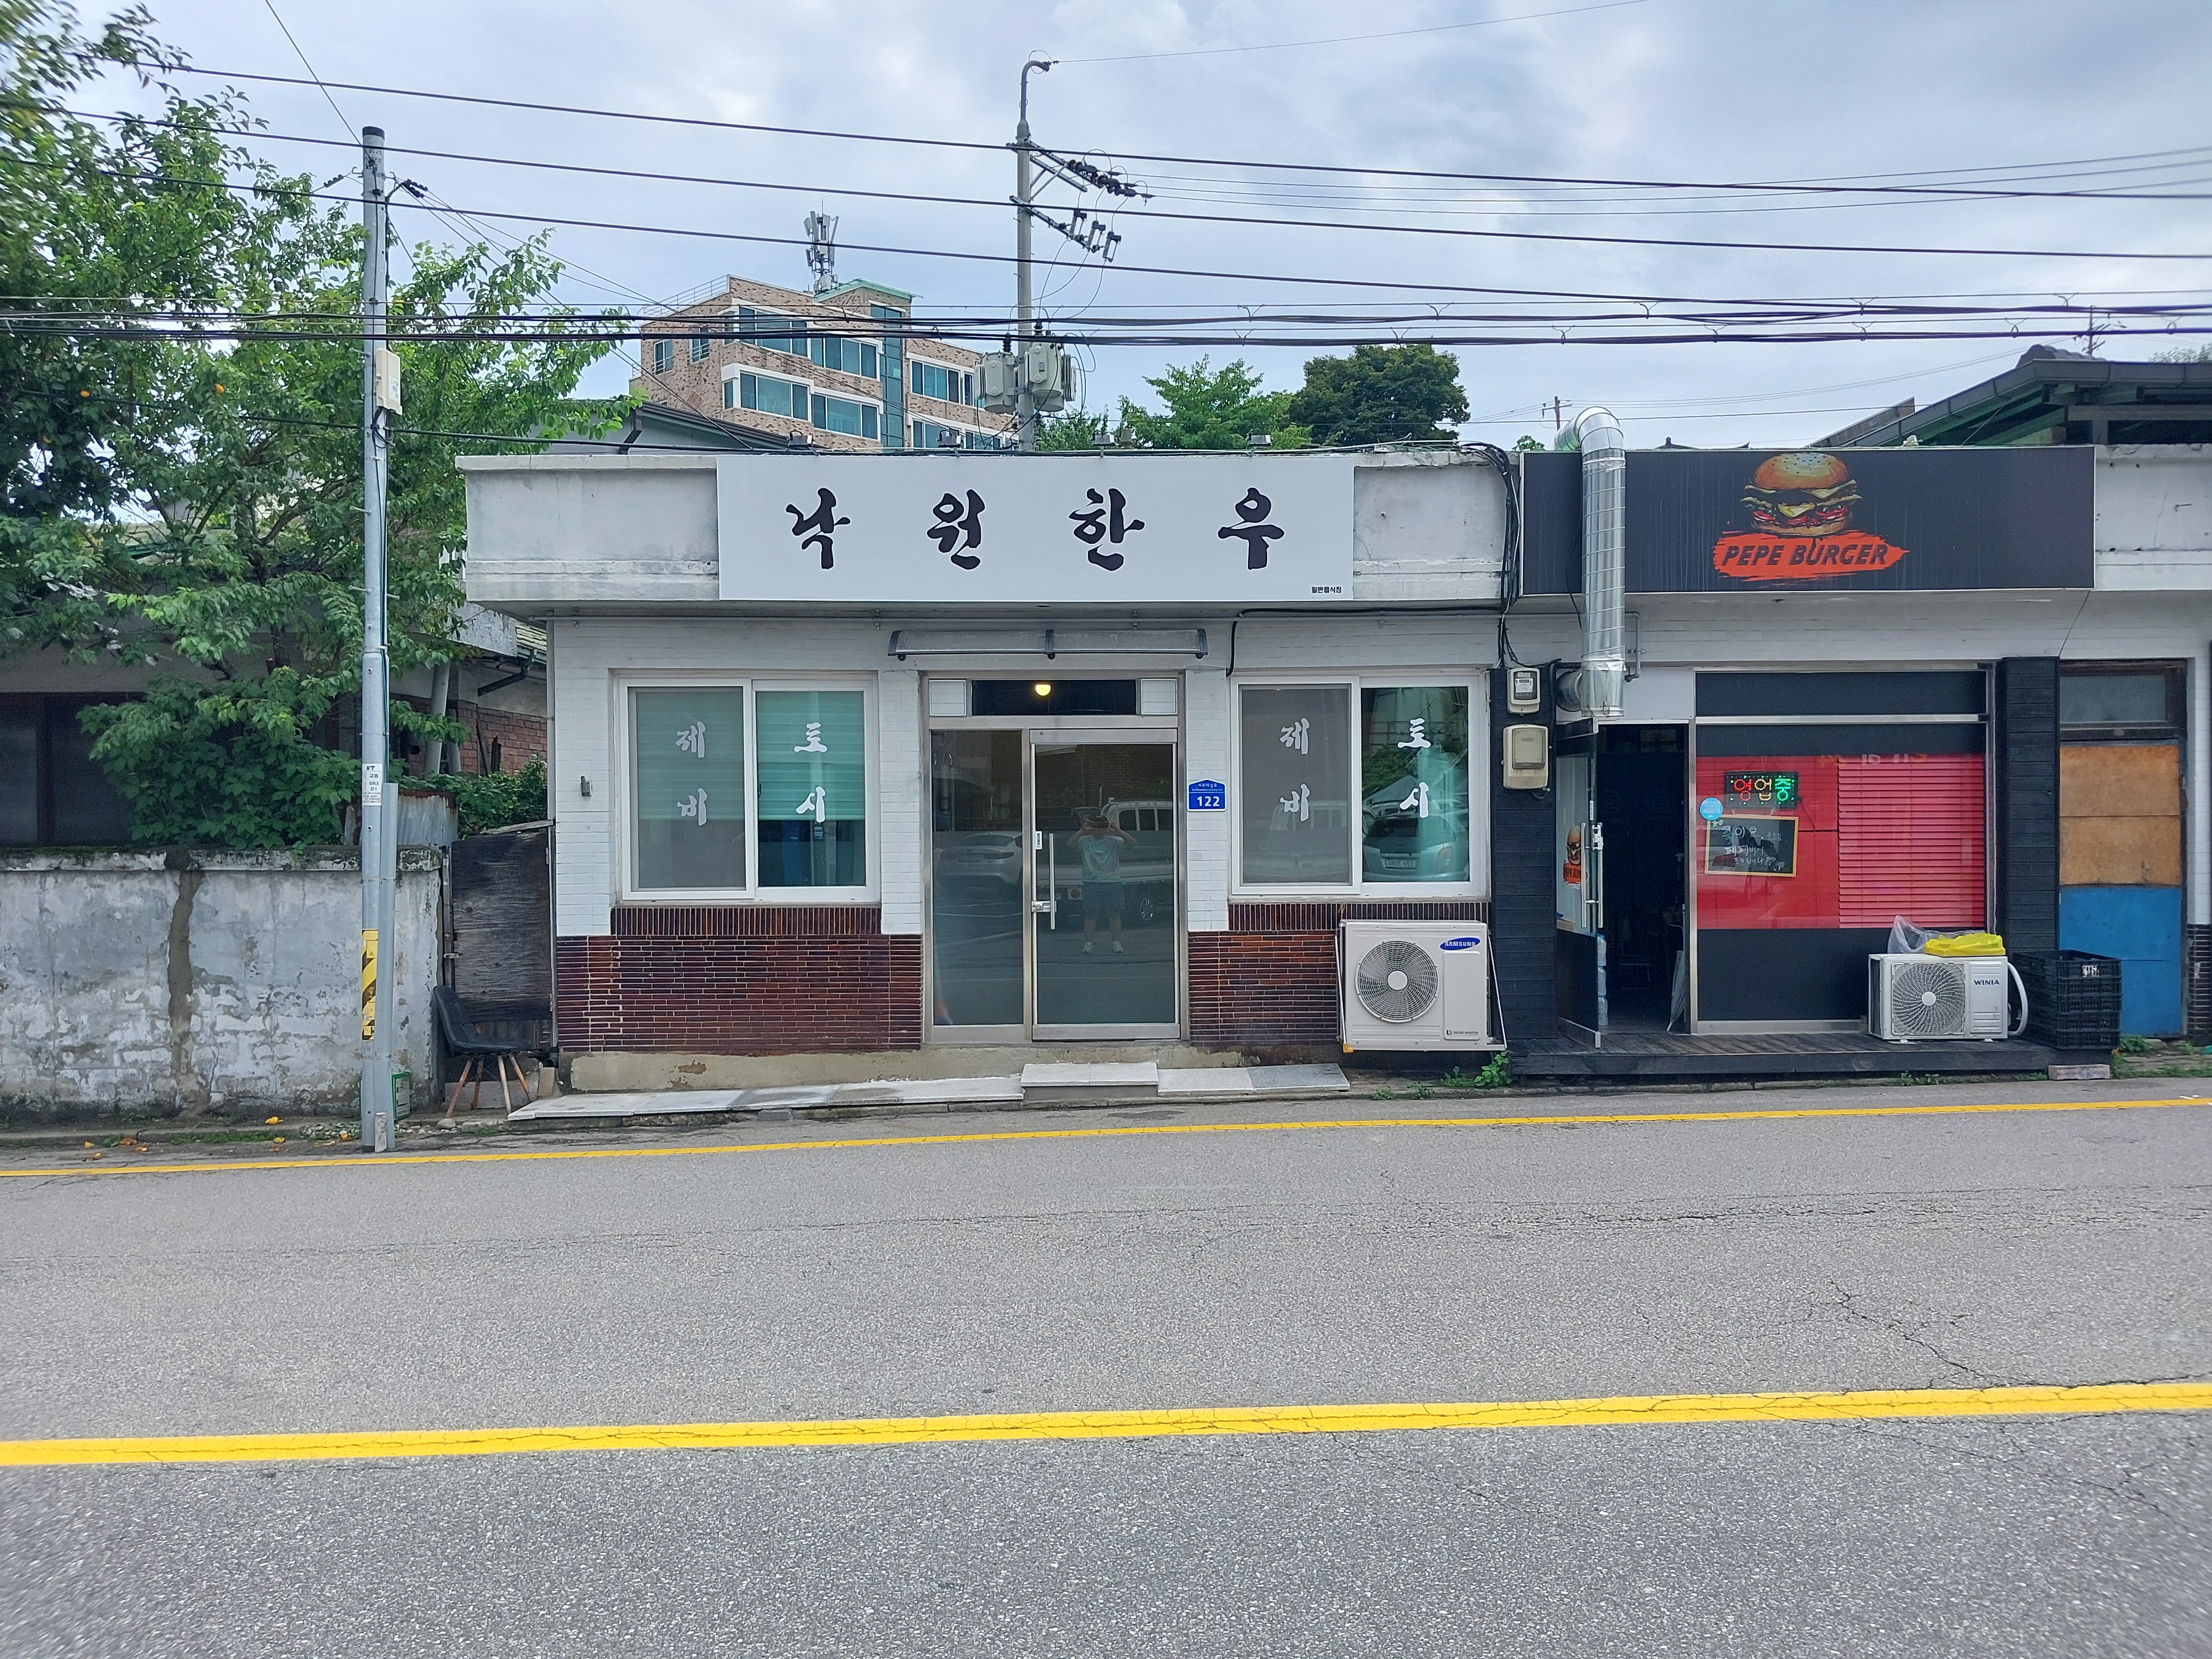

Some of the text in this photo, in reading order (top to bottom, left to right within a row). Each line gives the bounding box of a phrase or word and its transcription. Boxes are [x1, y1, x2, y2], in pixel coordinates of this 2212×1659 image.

[786, 487, 1285, 571] 낙원한우
[1722, 544, 1888, 566] PEPE BURGER
[1197, 796, 1220, 807] 122
[1733, 778, 1792, 802] 영업중
